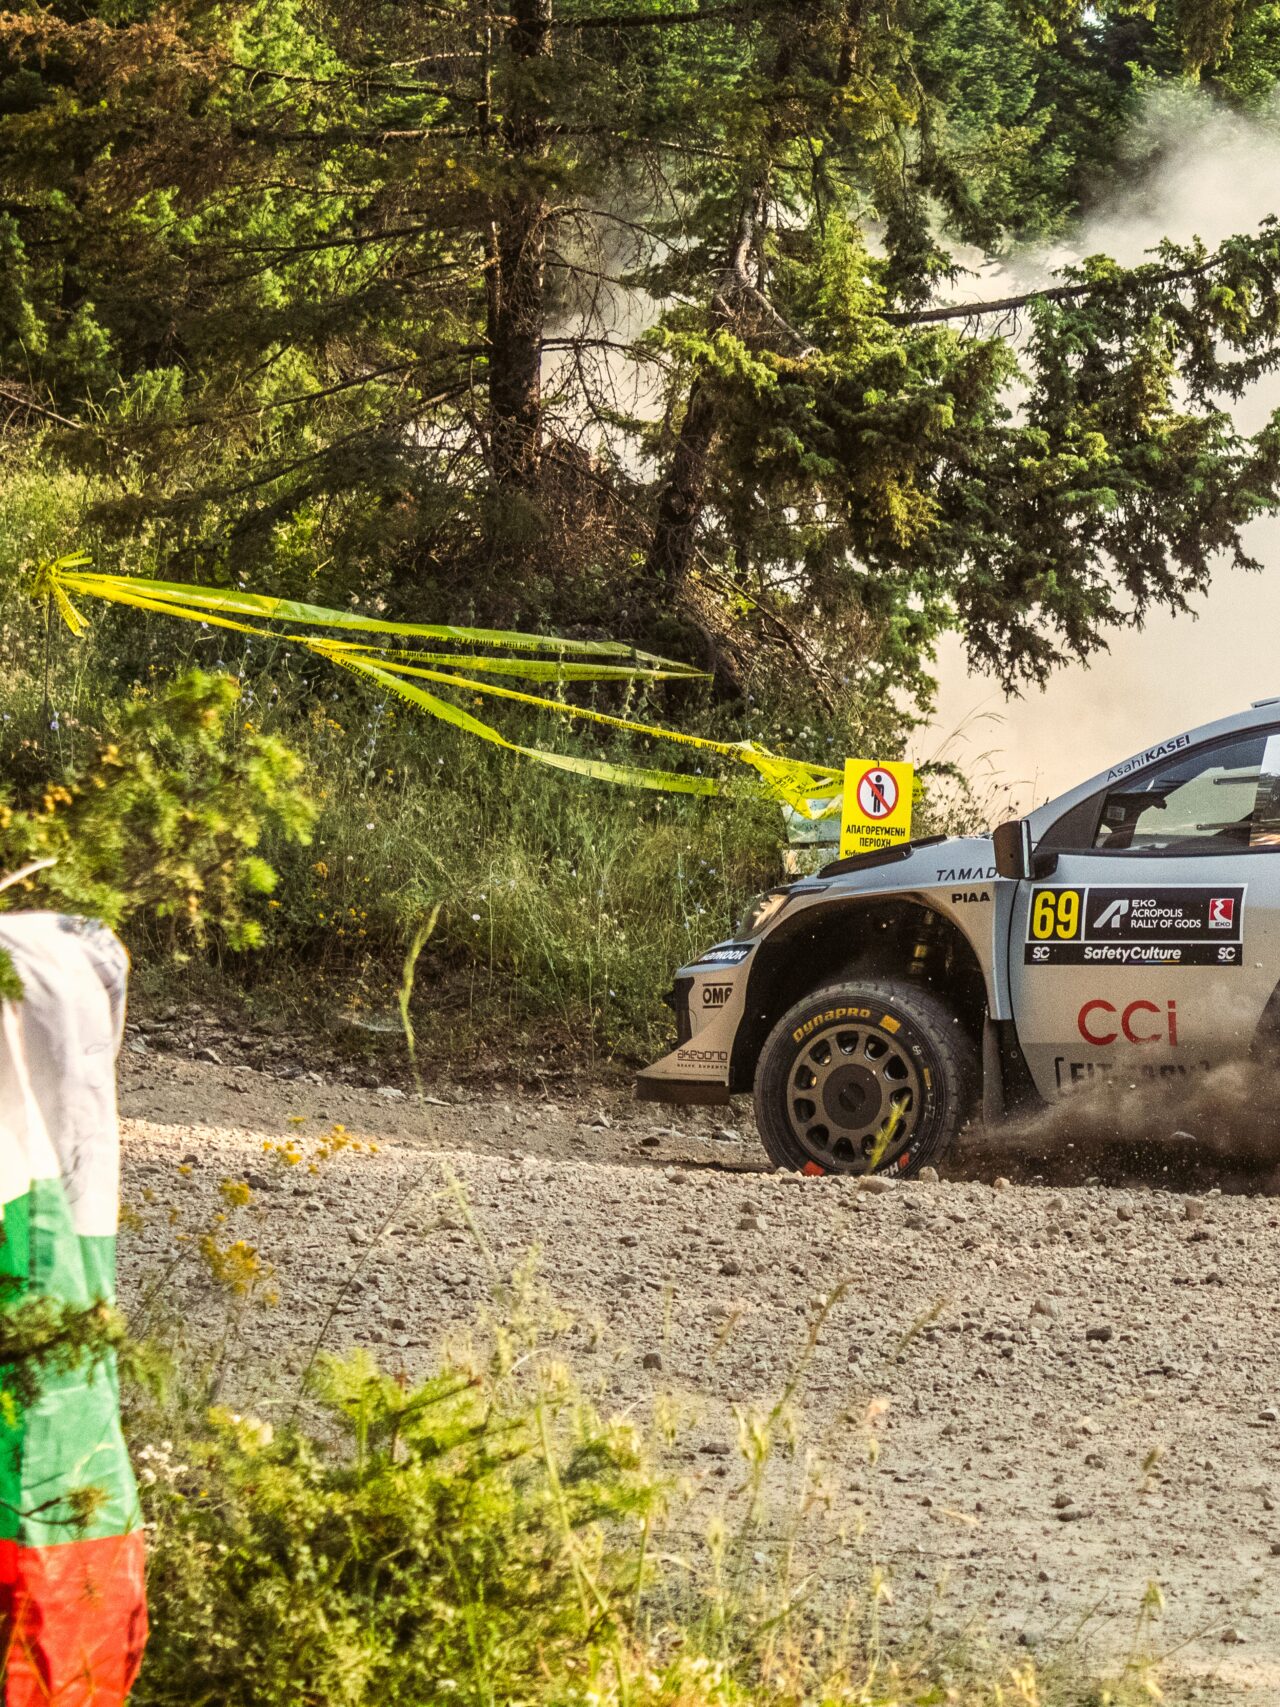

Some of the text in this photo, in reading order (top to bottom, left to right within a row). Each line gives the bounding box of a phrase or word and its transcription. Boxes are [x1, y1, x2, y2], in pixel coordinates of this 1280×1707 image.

[1106, 735, 1190, 782] AsahiKASEI
[846, 824, 906, 837] ΑΠΑΓΟΡΕΥΜΕΝΗ
[859, 837, 891, 848] ΠΕΡΙΟΧΗ
[951, 892, 990, 904] PIAA
[1131, 899, 1157, 908] EKO
[1032, 890, 1080, 940] 69
[1131, 908, 1183, 918] ACROPOLIS
[1130, 919, 1202, 929] RALLY OF GODS
[1032, 946, 1050, 959] SC
[1083, 946, 1182, 963] SafetyCulture
[1217, 946, 1236, 960] SC
